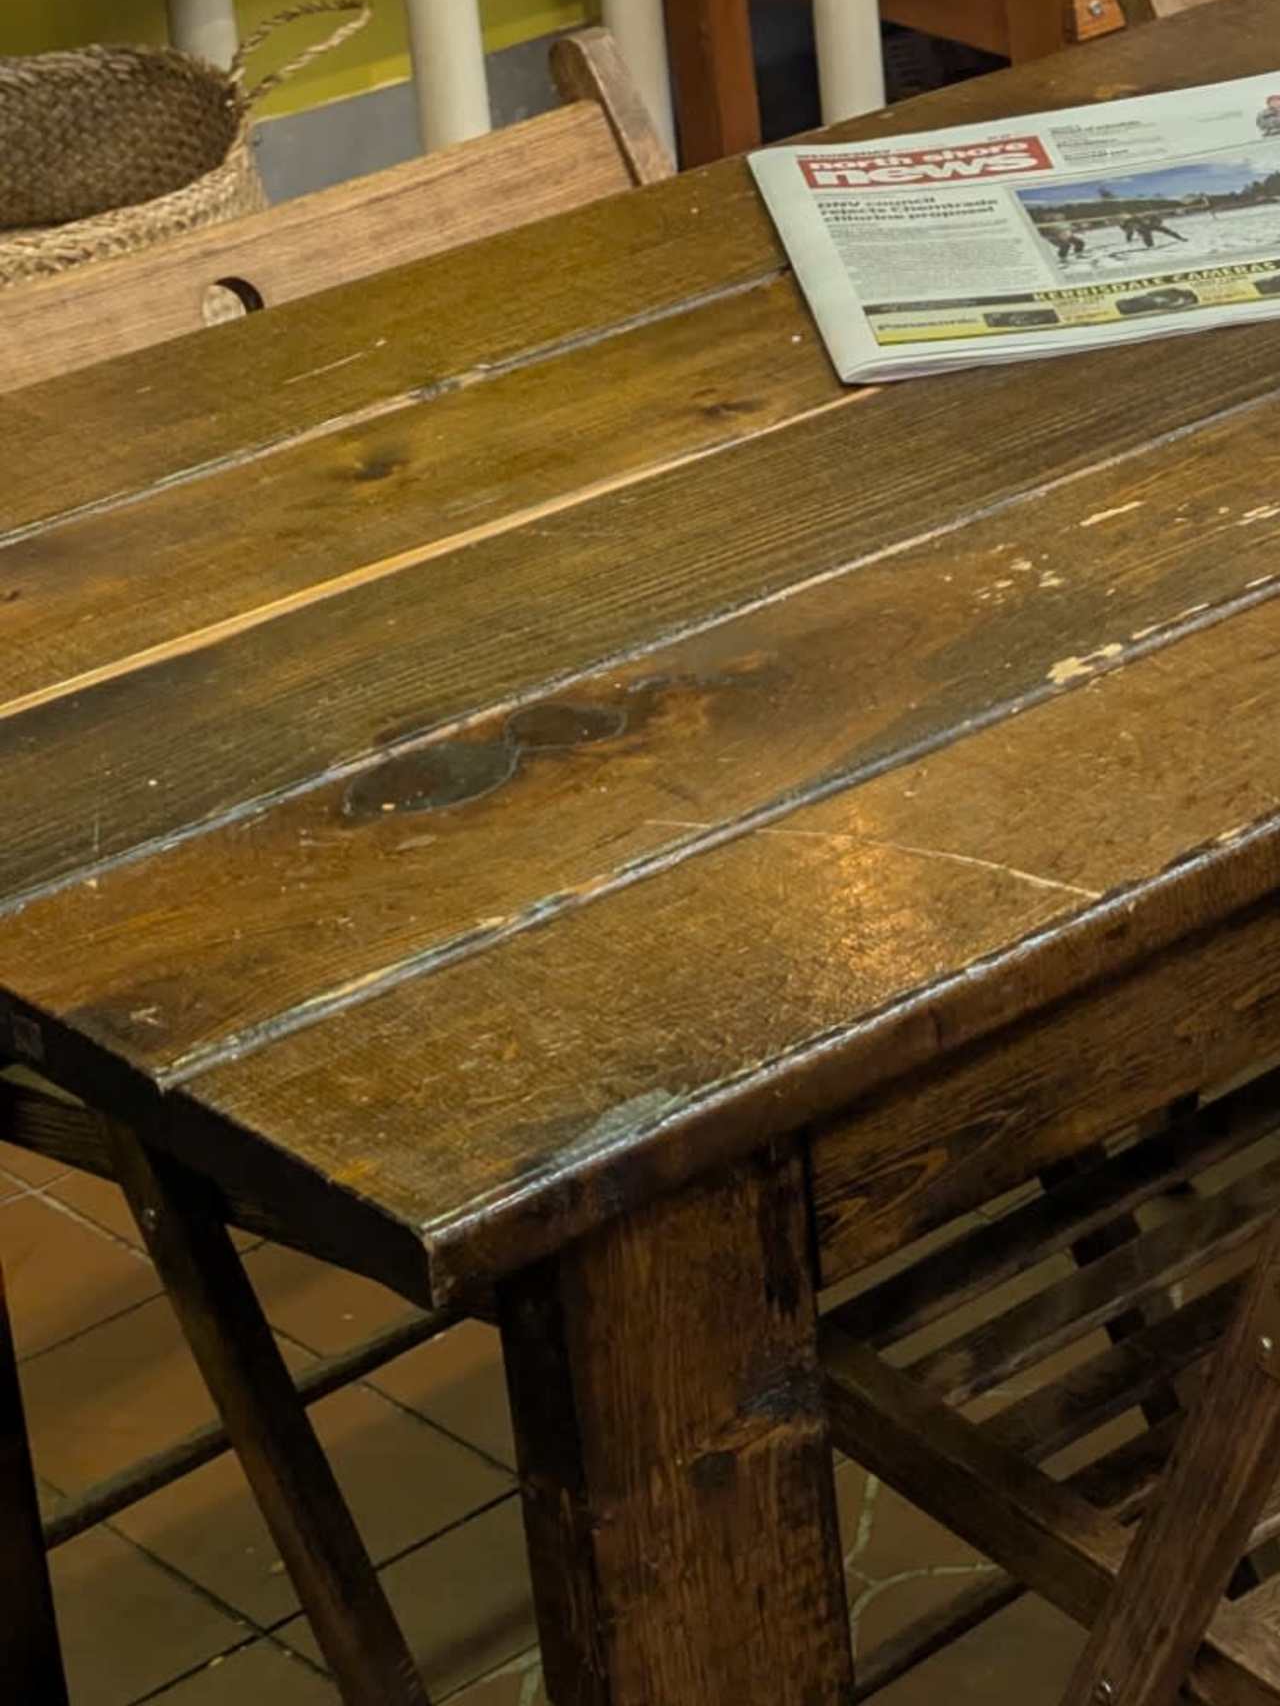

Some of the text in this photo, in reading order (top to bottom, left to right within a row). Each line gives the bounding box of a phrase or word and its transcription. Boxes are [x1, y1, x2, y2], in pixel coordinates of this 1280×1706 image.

[809, 153, 910, 171] north
[922, 140, 1029, 162] shore
[812, 152, 1039, 187] news
[908, 204, 995, 221] proposal
[1034, 261, 1277, 303] KERRISDALE CAMERAS
